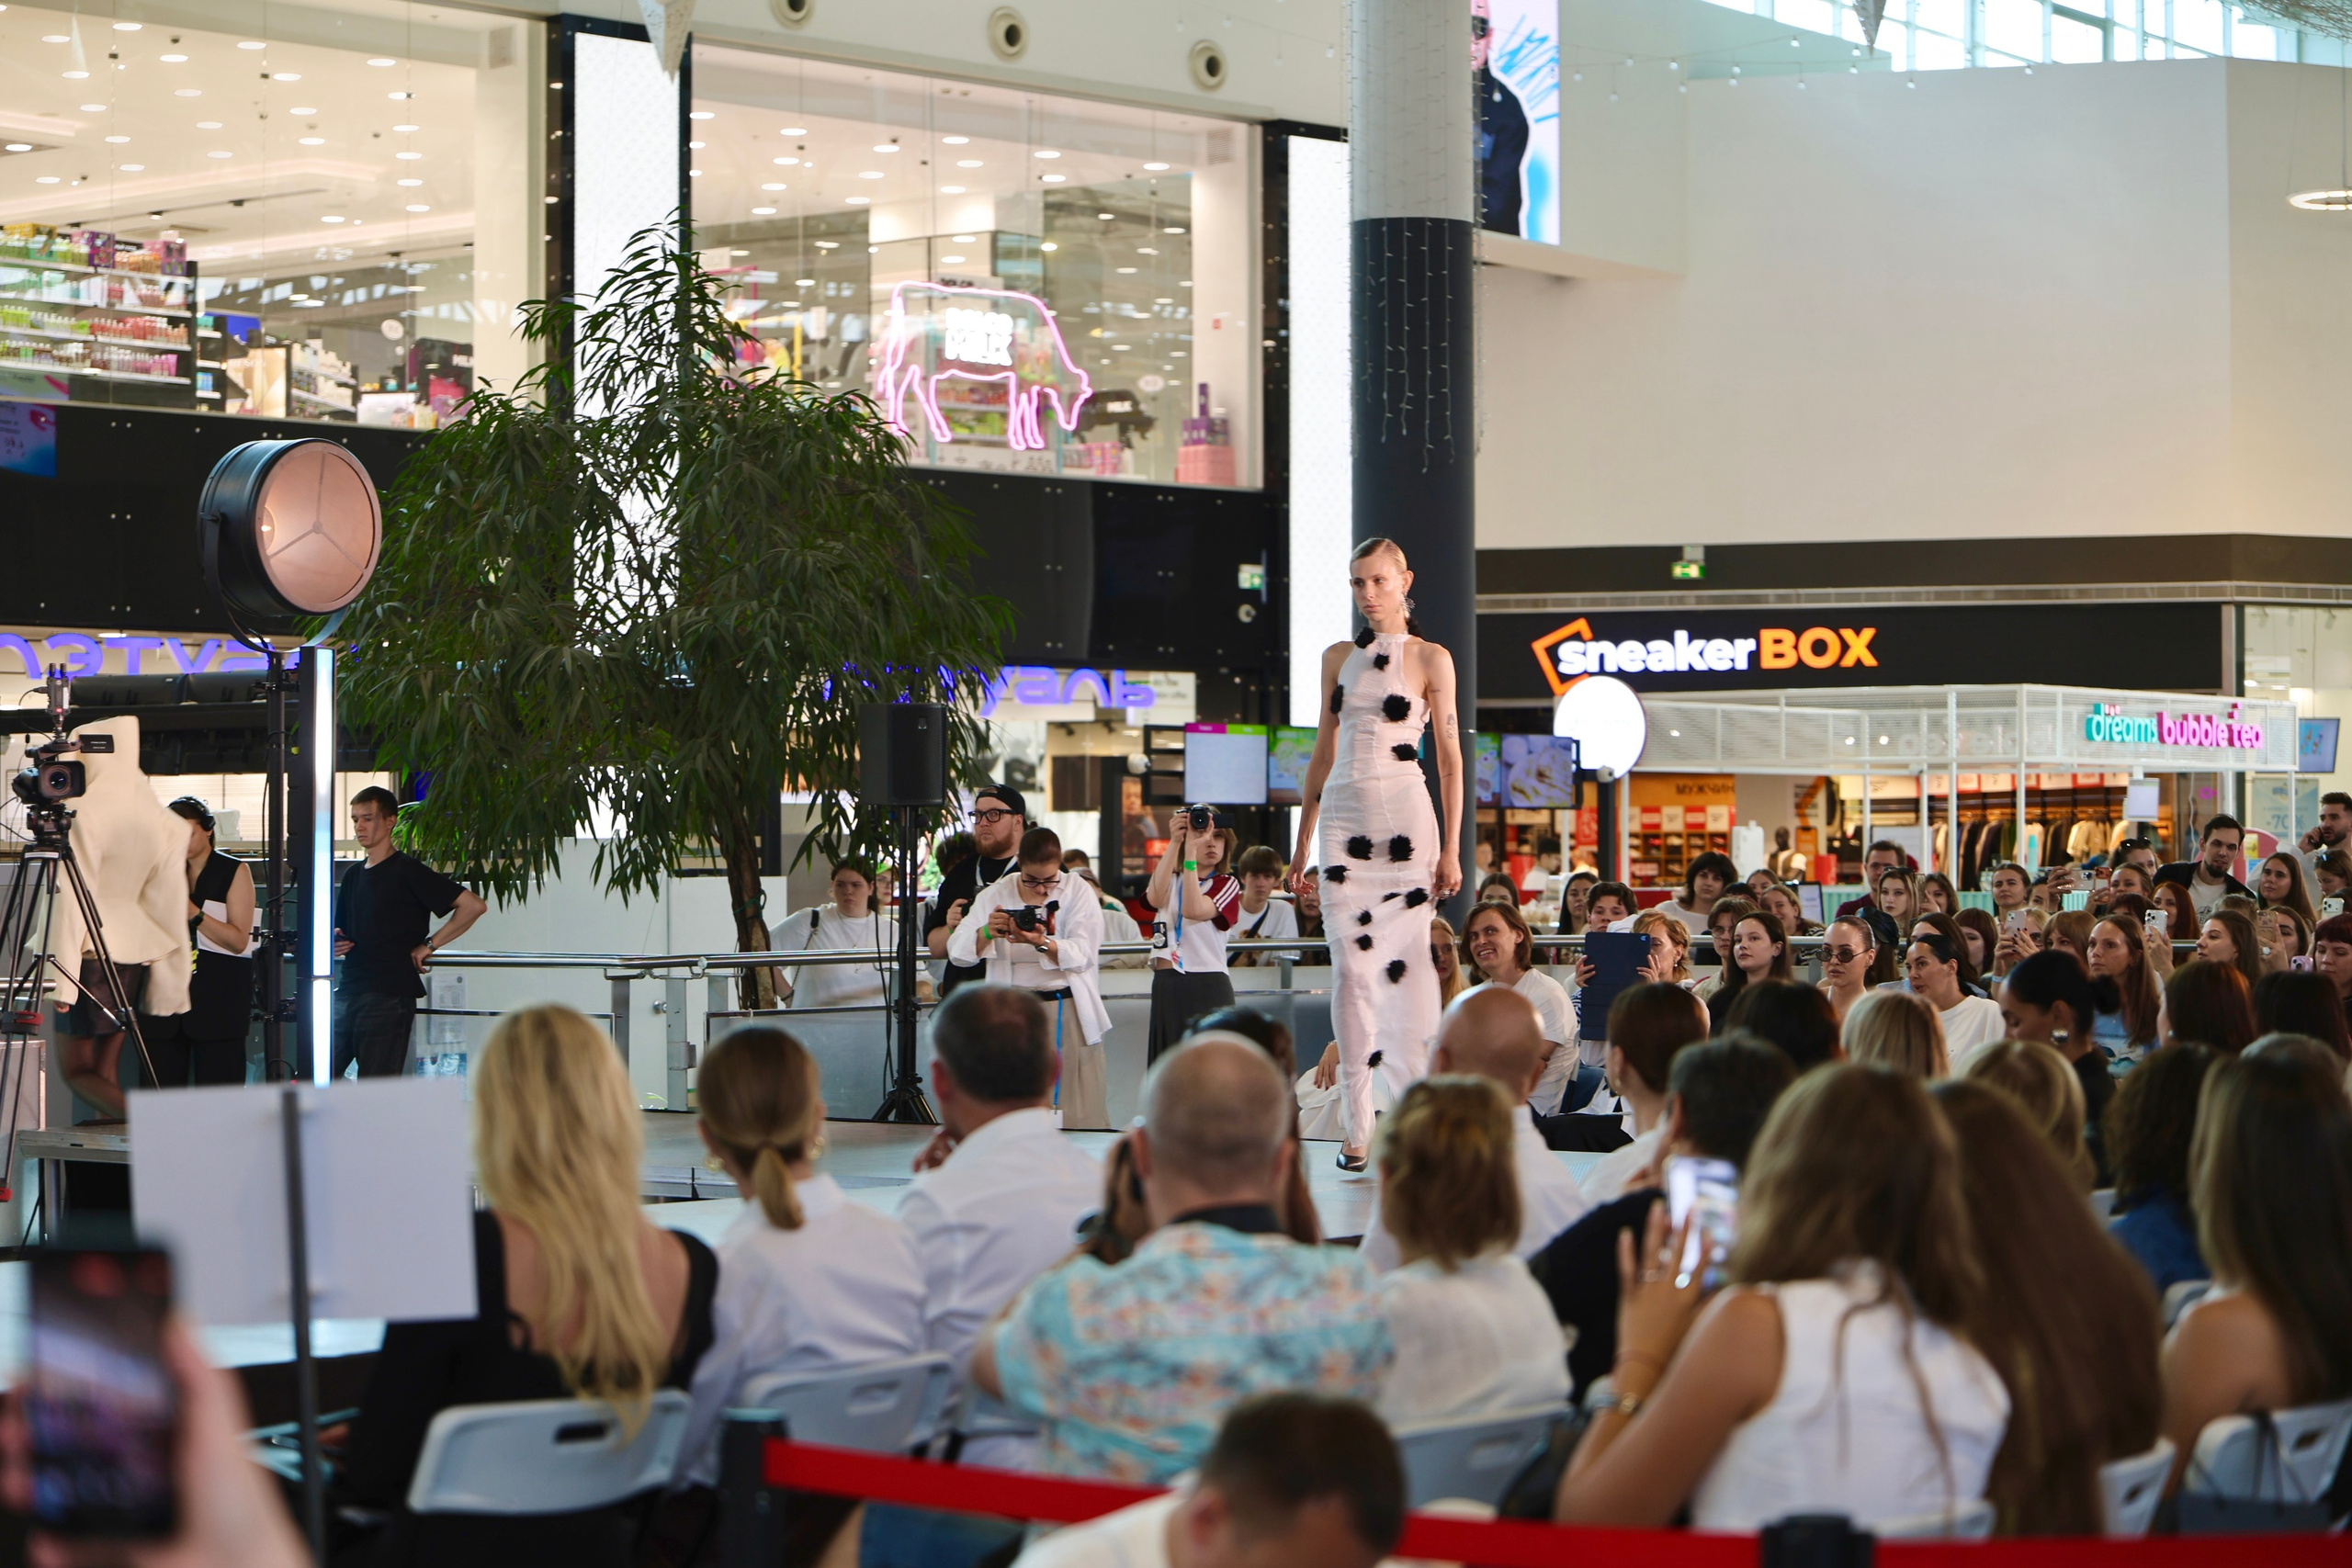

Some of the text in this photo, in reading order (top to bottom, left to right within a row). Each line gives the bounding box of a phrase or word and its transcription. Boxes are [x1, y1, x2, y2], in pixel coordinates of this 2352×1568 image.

[2086, 703, 2264, 750] dreams bubble tea
